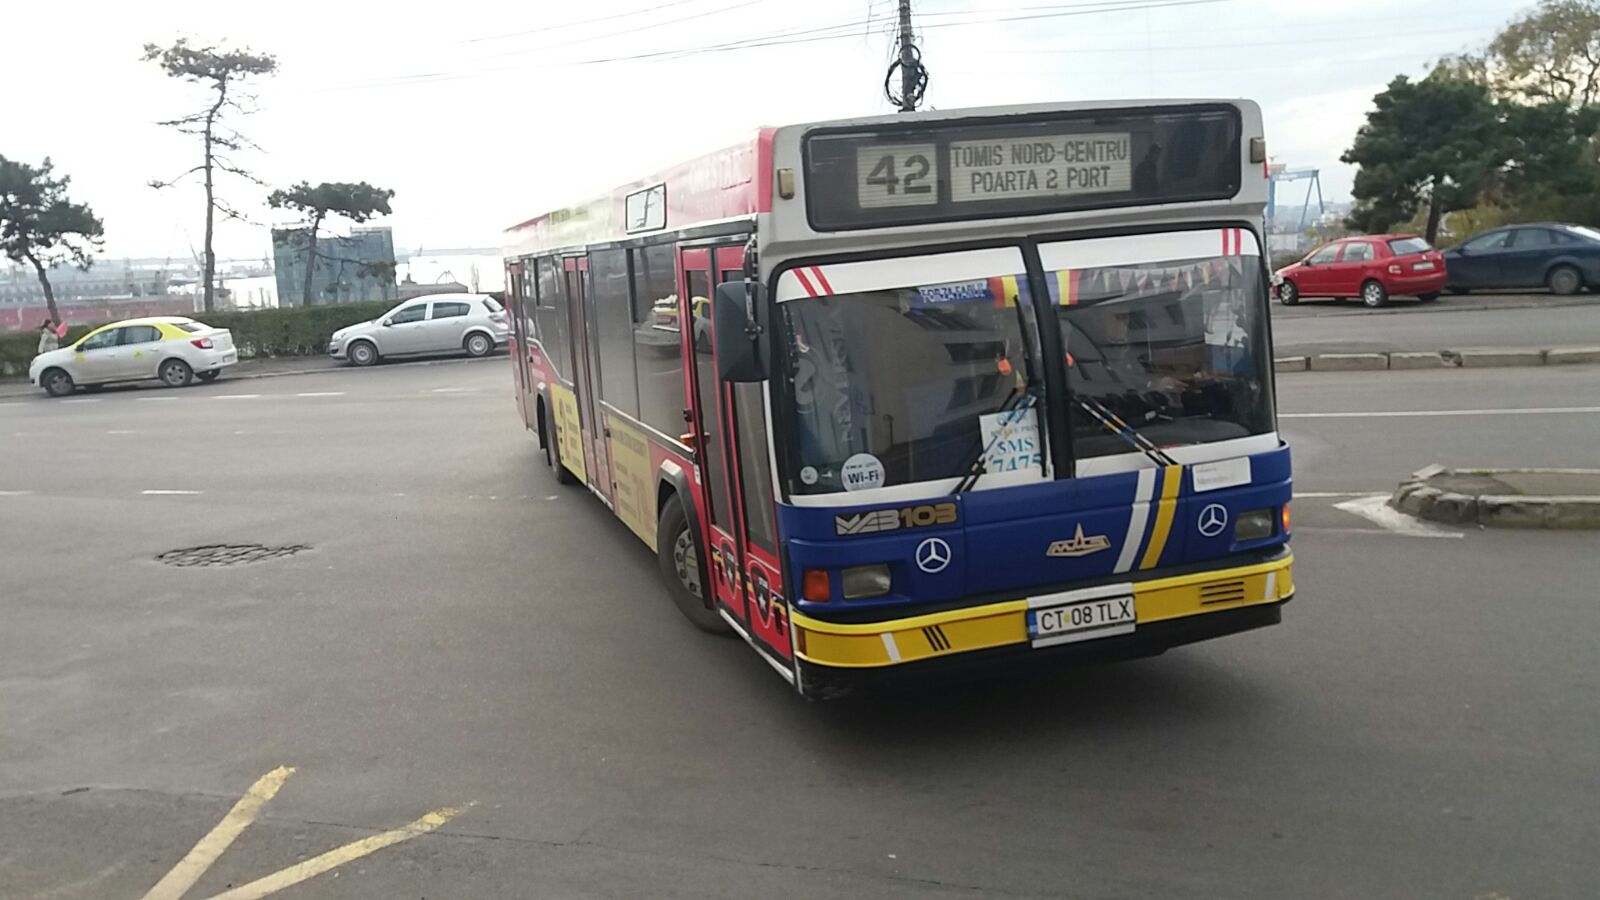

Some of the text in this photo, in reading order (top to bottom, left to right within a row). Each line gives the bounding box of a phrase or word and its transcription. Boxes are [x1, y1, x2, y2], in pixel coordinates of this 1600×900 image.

[952, 140, 1127, 168] TOMIS NORD-CENTRU
[866, 154, 931, 195] 42
[971, 166, 1110, 194] POARTA 2 PORT
[996, 438, 1034, 454] SMS
[848, 470, 880, 484] Wi-Fi
[1041, 600, 1131, 631] CT 08 TLX
